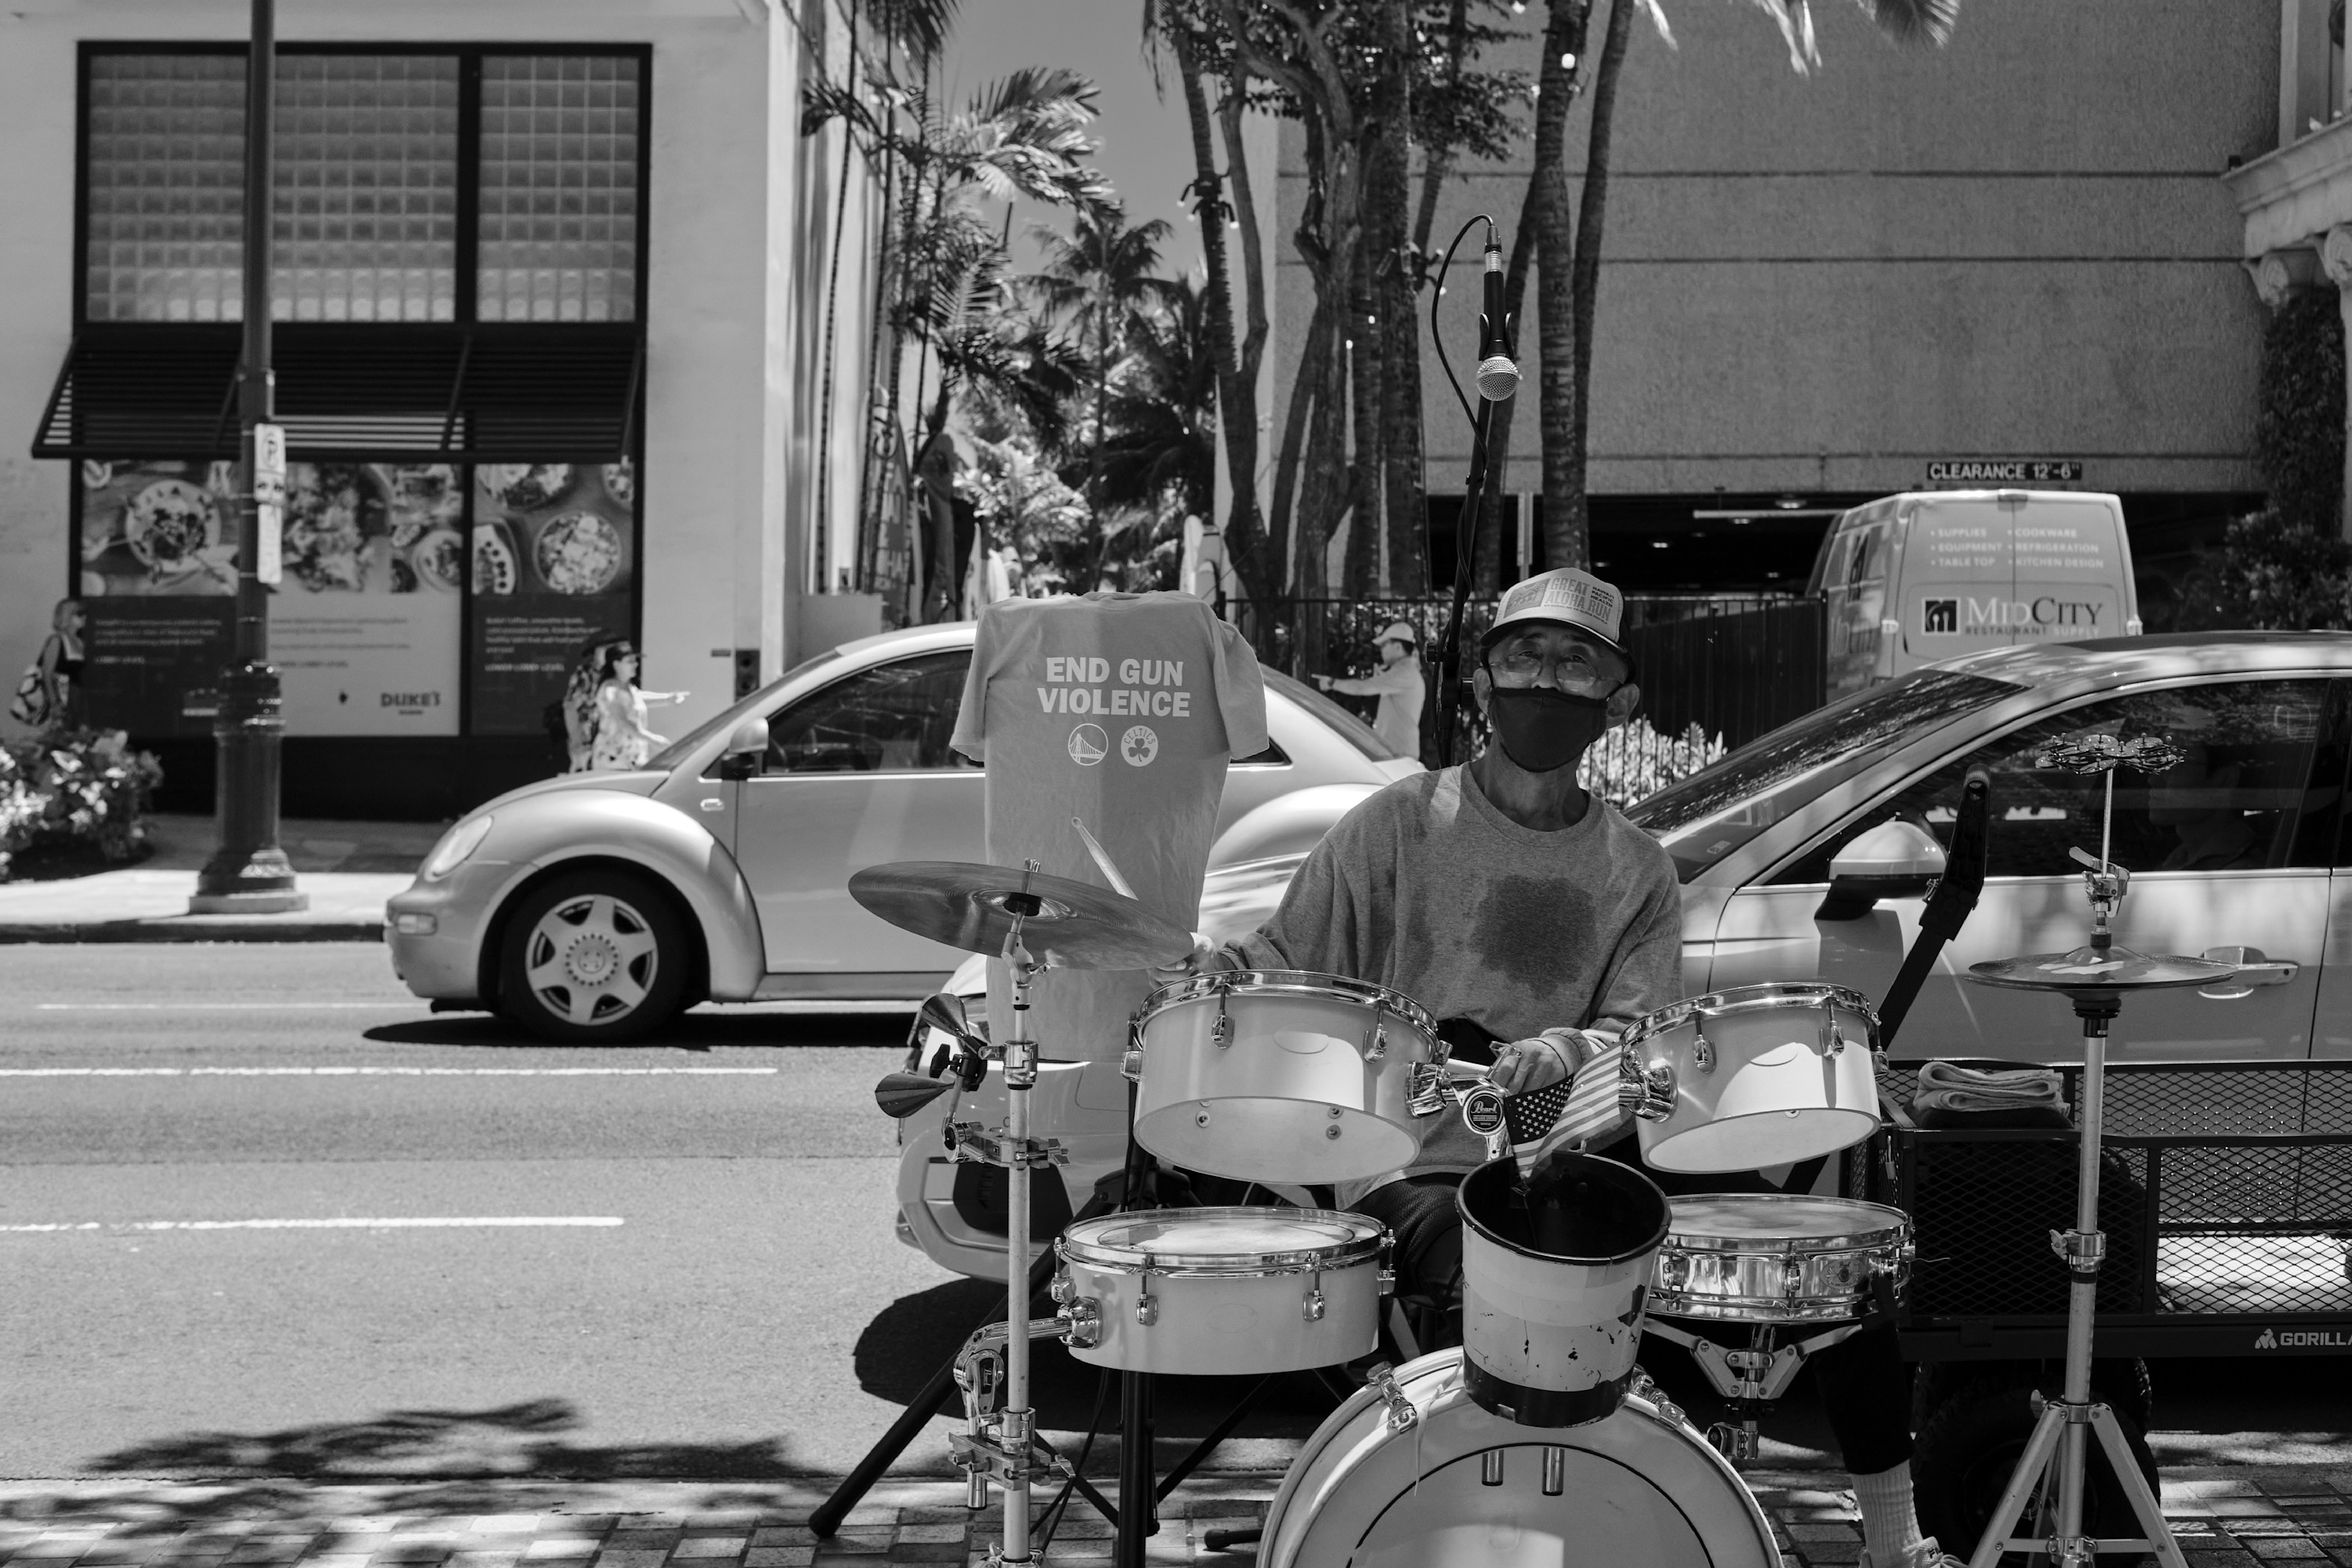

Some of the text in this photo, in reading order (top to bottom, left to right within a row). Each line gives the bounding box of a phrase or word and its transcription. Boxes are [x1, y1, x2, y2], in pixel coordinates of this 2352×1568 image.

[1929, 463, 2026, 480] CLEARANCE
[1938, 528, 1987, 538] SUPPLIES
[2014, 528, 2078, 539] COOKWARE
[1938, 543, 2003, 553] EQUIPMENT
[2015, 543, 2100, 554] REFRIGERATION
[1939, 557, 1996, 568] TABLE TOP
[2015, 557, 2104, 569] KITCHEN DESIGN
[1550, 577, 1590, 596] GREAT
[1590, 594, 1613, 608] HEALTH
[1591, 590, 1614, 604] PACIFIC
[1545, 590, 1586, 610] ALOHA
[1588, 598, 1612, 622] RUN
[1965, 625, 2101, 640] RESTAURANT SUPPLY
[1047, 657, 1184, 687] END GUN
[1037, 688, 1191, 717] VIOLENCE
[1123, 728, 1156, 745] CELTICS
[1471, 1100, 1498, 1114] Pearl
